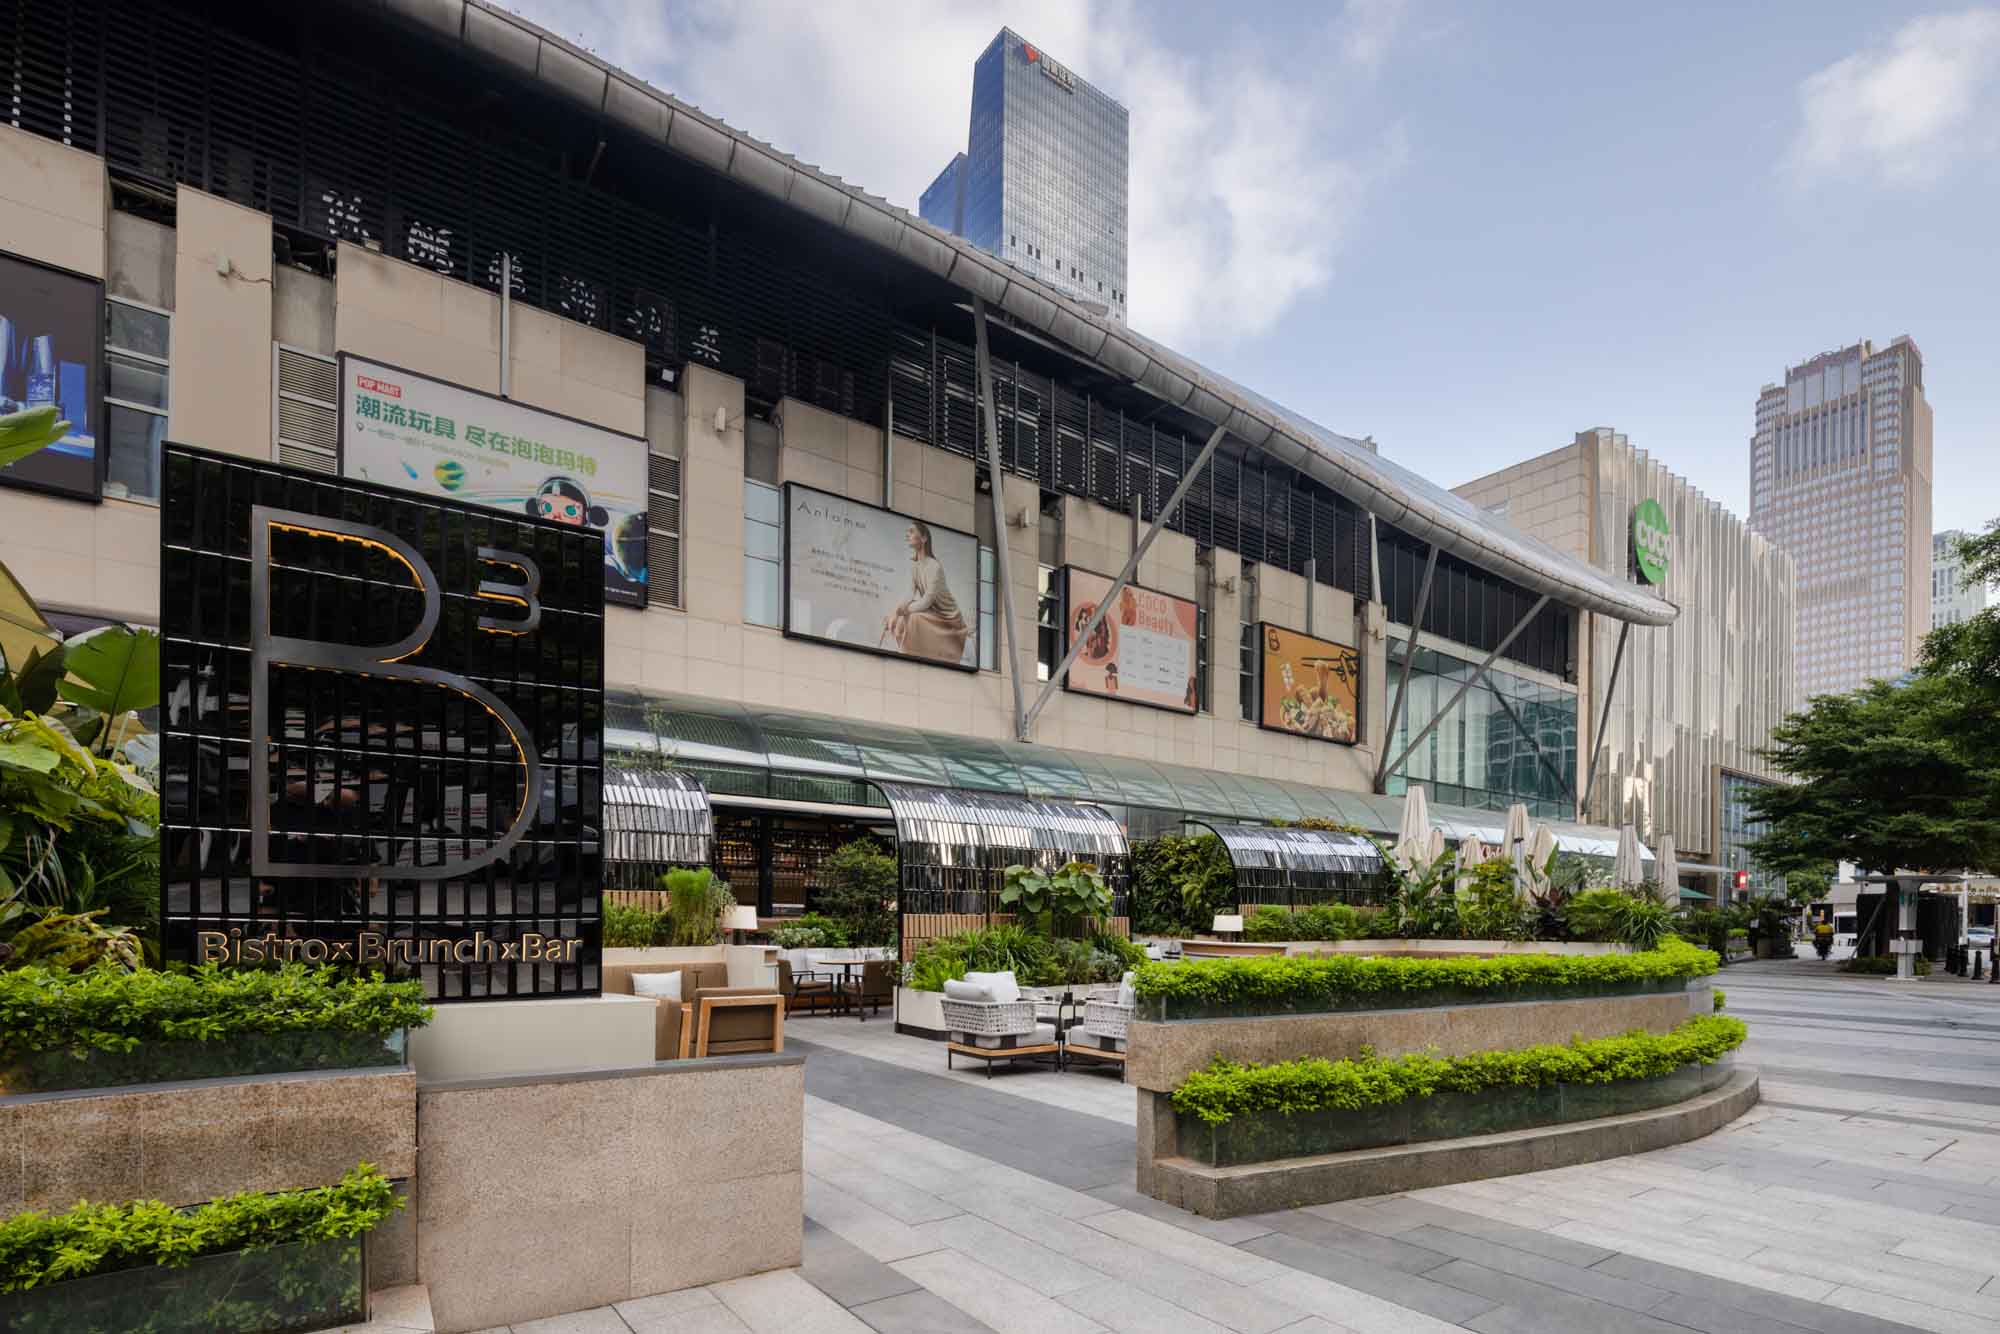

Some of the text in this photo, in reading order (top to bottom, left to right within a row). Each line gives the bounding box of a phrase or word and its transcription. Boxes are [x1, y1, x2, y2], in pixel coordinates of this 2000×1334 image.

[358, 377, 401, 397] POP MART
[356, 395, 456, 440] 潮流玩具
[465, 425, 597, 475] 尽在泡泡玛特
